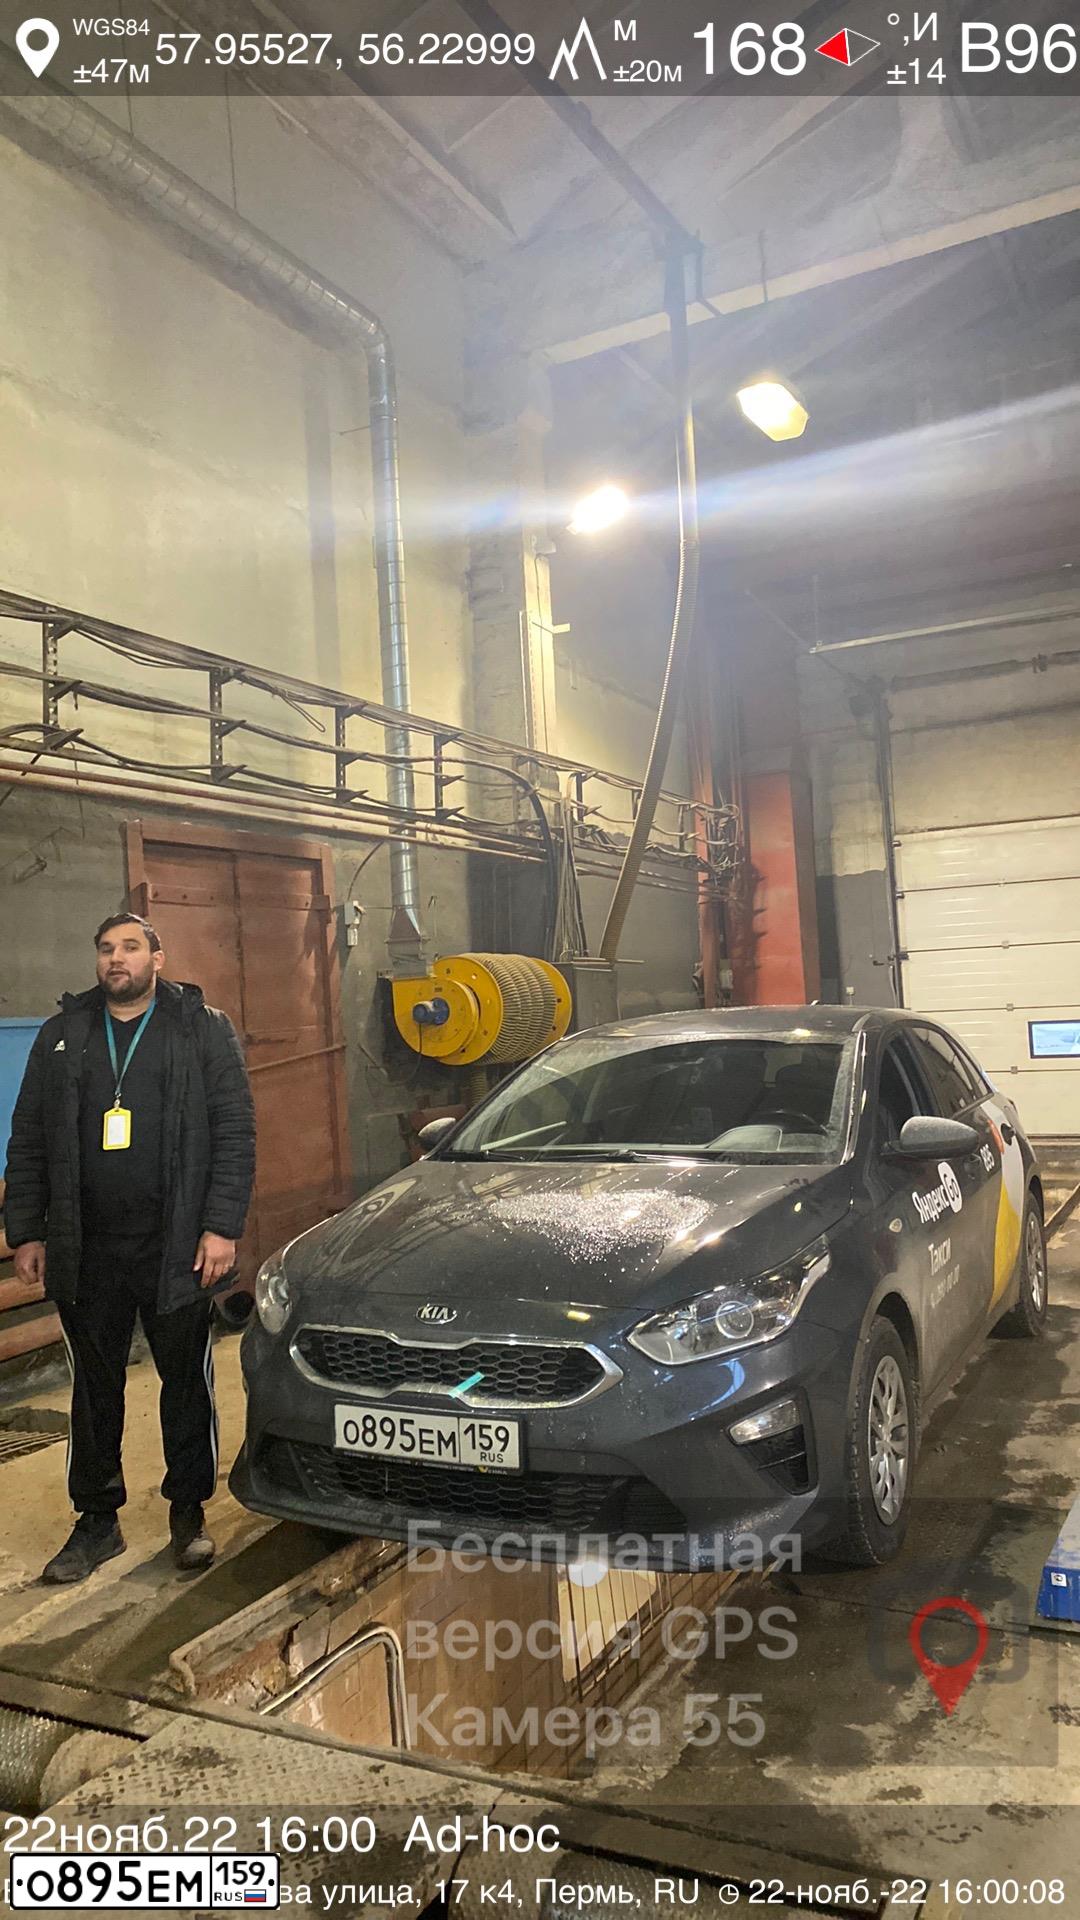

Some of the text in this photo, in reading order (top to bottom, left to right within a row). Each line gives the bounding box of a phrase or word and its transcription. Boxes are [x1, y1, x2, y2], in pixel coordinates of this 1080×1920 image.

[911, 1184, 950, 1224] Яндекс
[928, 1237, 952, 1276] Такси
[420, 1305, 450, 1320] KIA
[463, 1422, 510, 1452] 159
[479, 1451, 504, 1464] RUS
